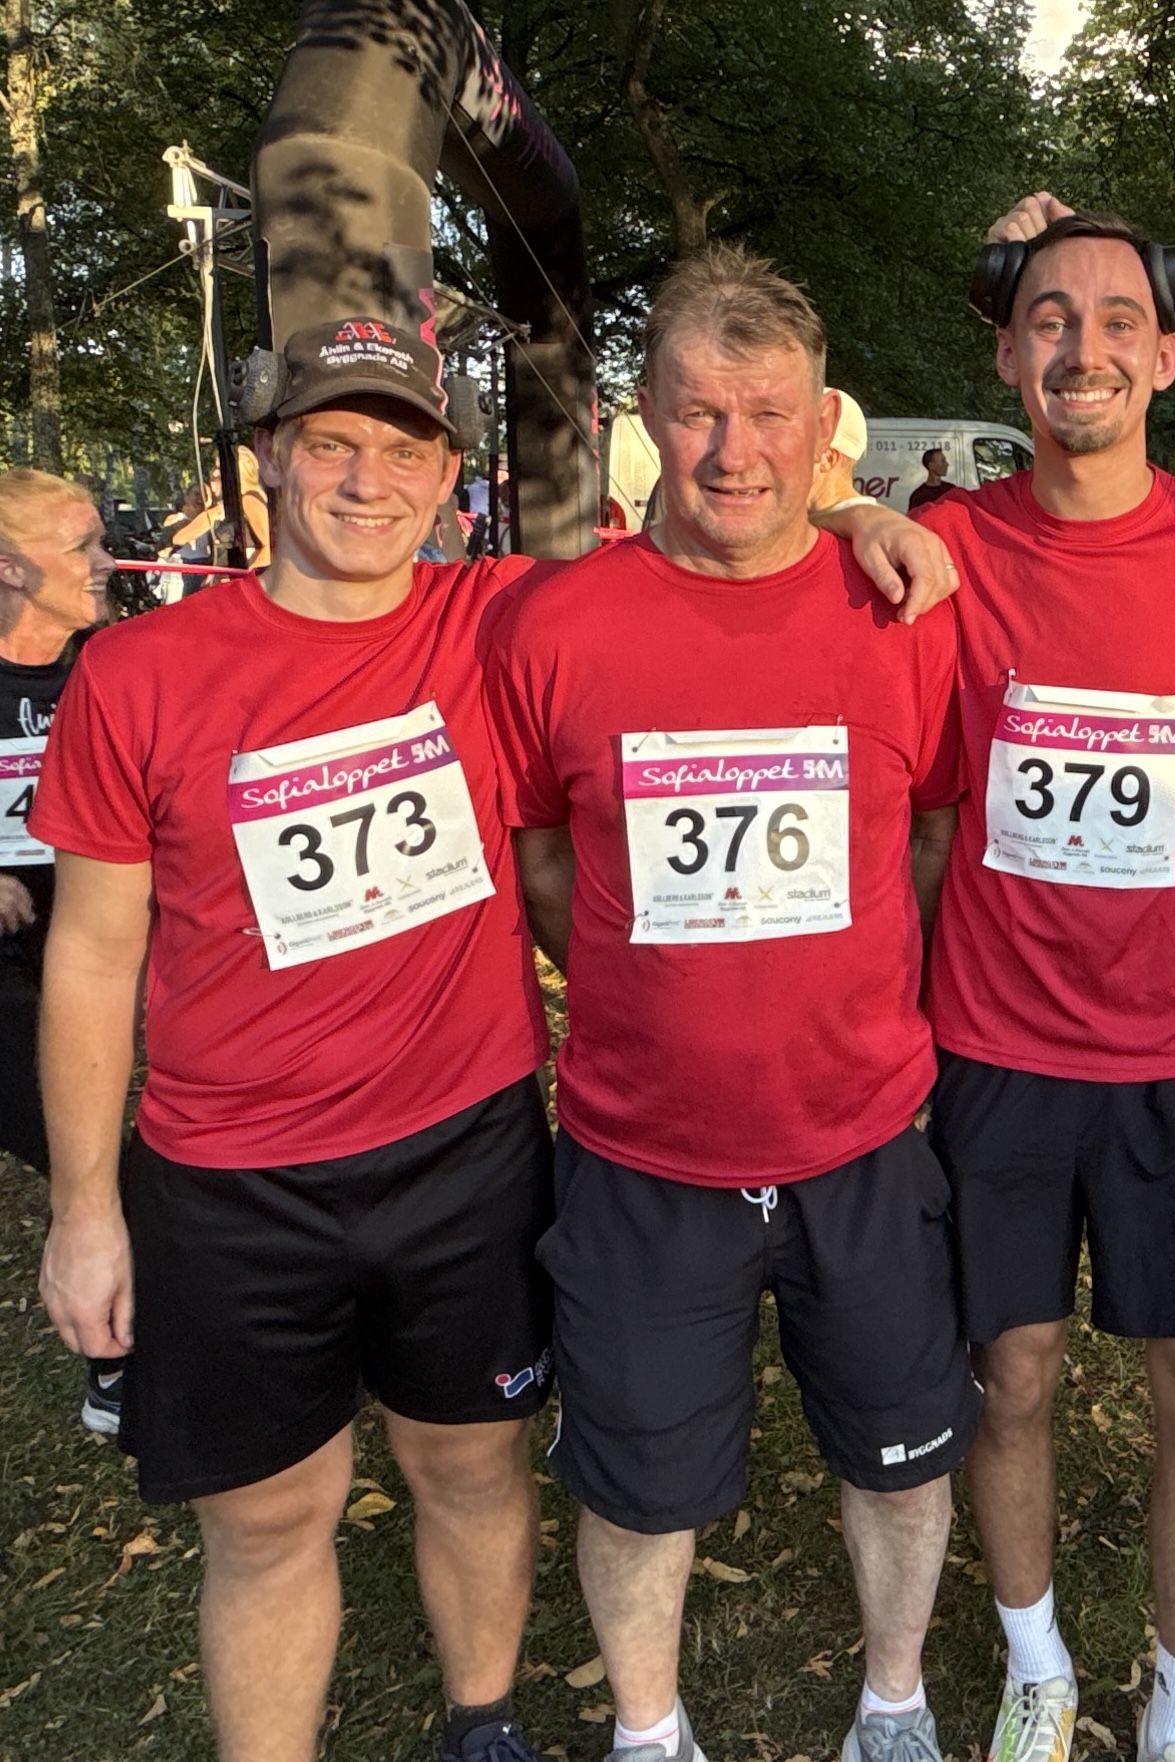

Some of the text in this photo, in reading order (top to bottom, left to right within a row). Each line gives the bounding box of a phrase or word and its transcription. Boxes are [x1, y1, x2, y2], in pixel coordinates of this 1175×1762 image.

[353, 341, 365, 351] &
[389, 356, 408, 370] AB
[875, 440, 897, 451] 011
[907, 440, 928, 451] 122
[1003, 715, 1145, 750] Sofialoppet
[240, 734, 451, 810] Sofialoppet 5KM
[638, 758, 844, 792] Sofialoppet 5KM
[1015, 757, 1151, 827] 379
[5, 784, 35, 825] 4
[278, 790, 438, 892] 373
[665, 802, 810, 875] 376
[1125, 844, 1165, 855] stadium
[425, 857, 468, 881] stadium
[1100, 866, 1138, 877] saucony
[408, 891, 446, 913] saucony
[786, 888, 831, 900] stadium
[760, 915, 802, 926] saucony
[907, 1427, 953, 1460] BYGGNADS
